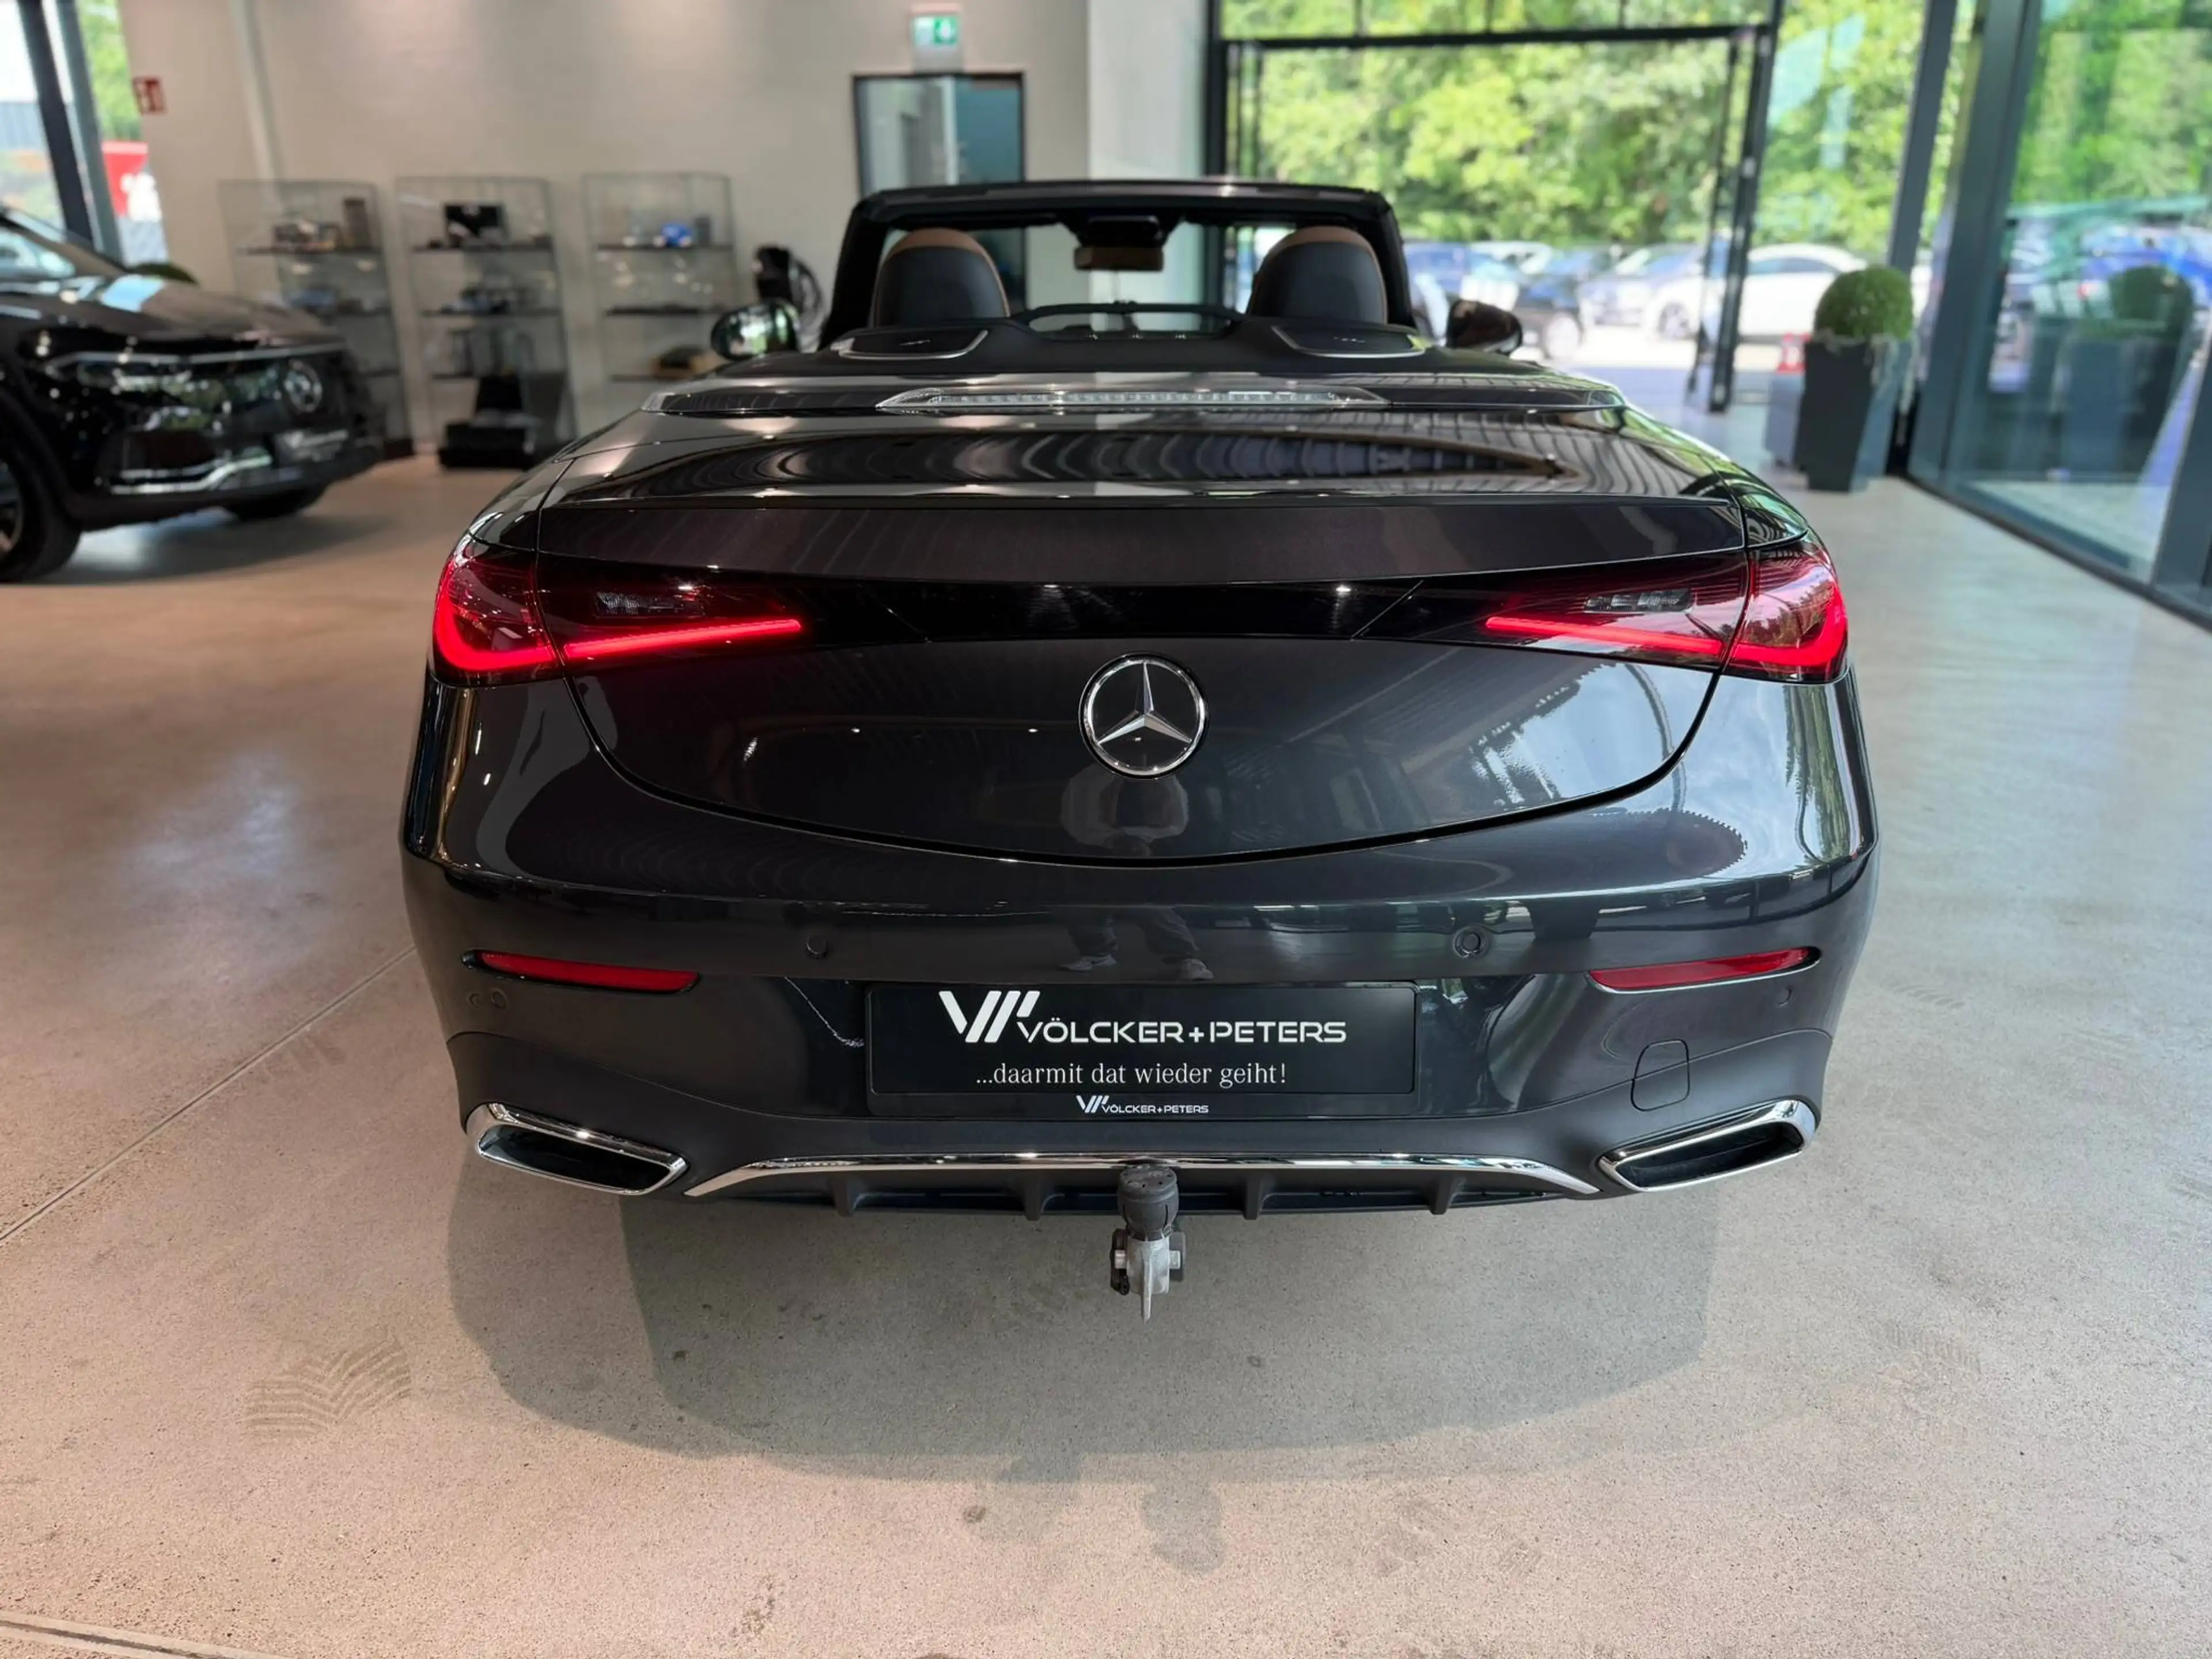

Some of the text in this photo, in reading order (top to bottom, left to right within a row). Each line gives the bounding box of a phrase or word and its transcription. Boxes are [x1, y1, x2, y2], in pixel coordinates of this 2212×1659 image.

[976, 1062, 1286, 1089] ...daarmit dat wieder geiht!
